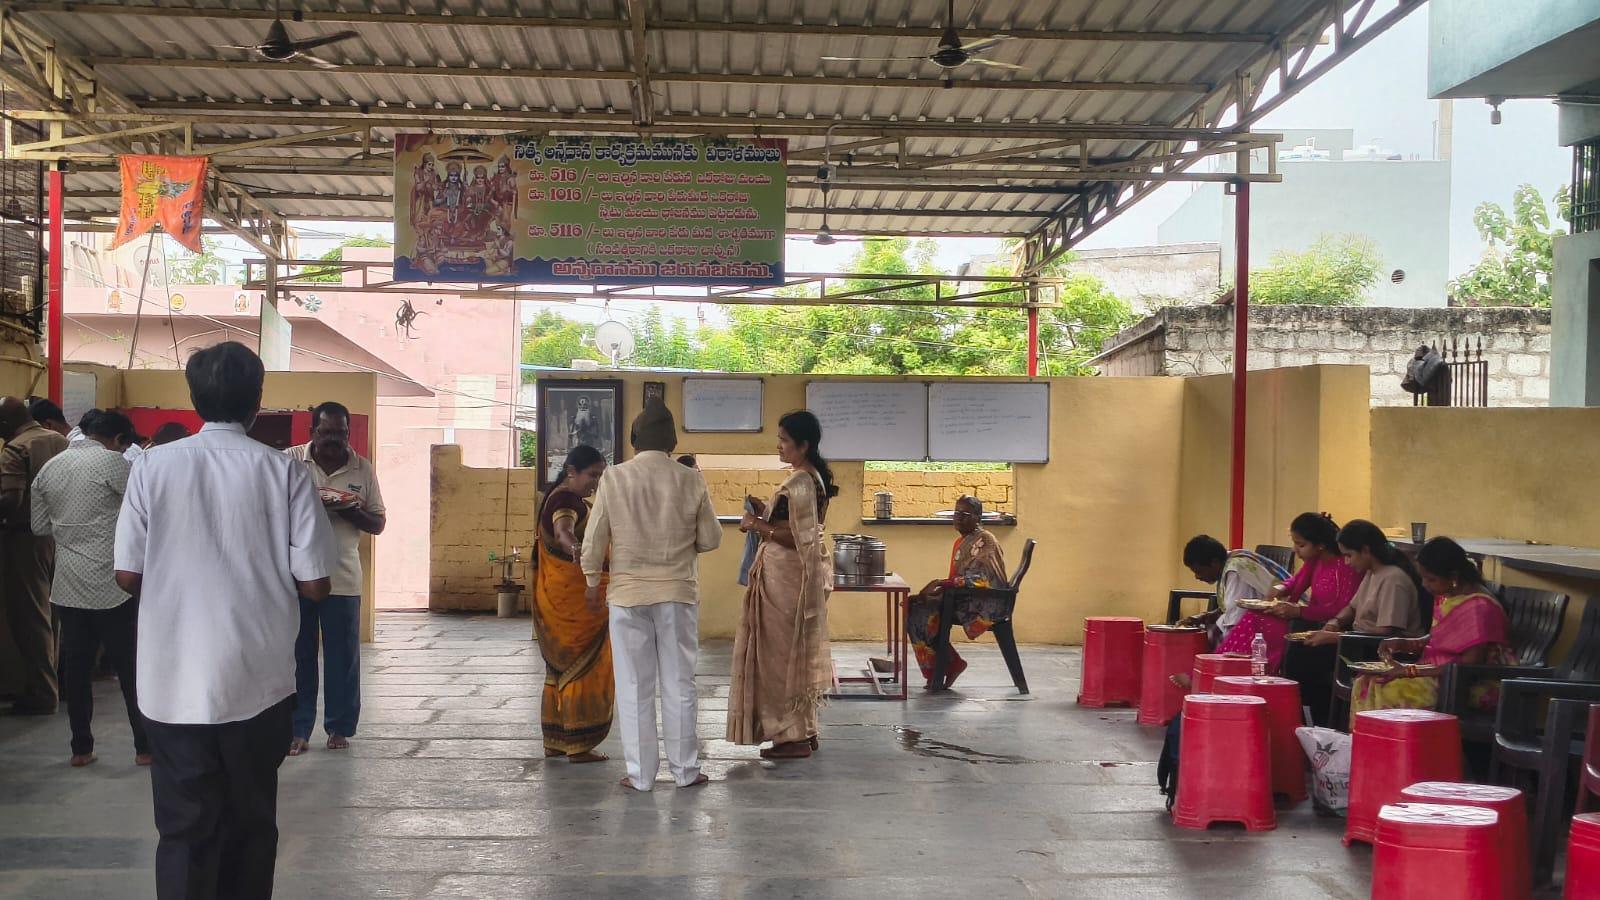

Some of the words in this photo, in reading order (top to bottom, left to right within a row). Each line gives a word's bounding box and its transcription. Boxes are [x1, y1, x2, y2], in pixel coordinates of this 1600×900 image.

[513, 142, 543, 166] నిత్య
[543, 142, 592, 164] అన్నదాన
[594, 142, 700, 167] కార్యక్రమమునకు
[704, 143, 782, 163] విరాళములు
[529, 169, 548, 182] రూ.
[550, 168, 577, 182] 516
[528, 188, 547, 201] రూ.
[549, 187, 582, 201] 1016
[528, 225, 547, 238] రూ.
[549, 223, 583, 237] 5116
[552, 260, 657, 280] అన్నదానము
[660, 261, 773, 278] జరుపబడును.
